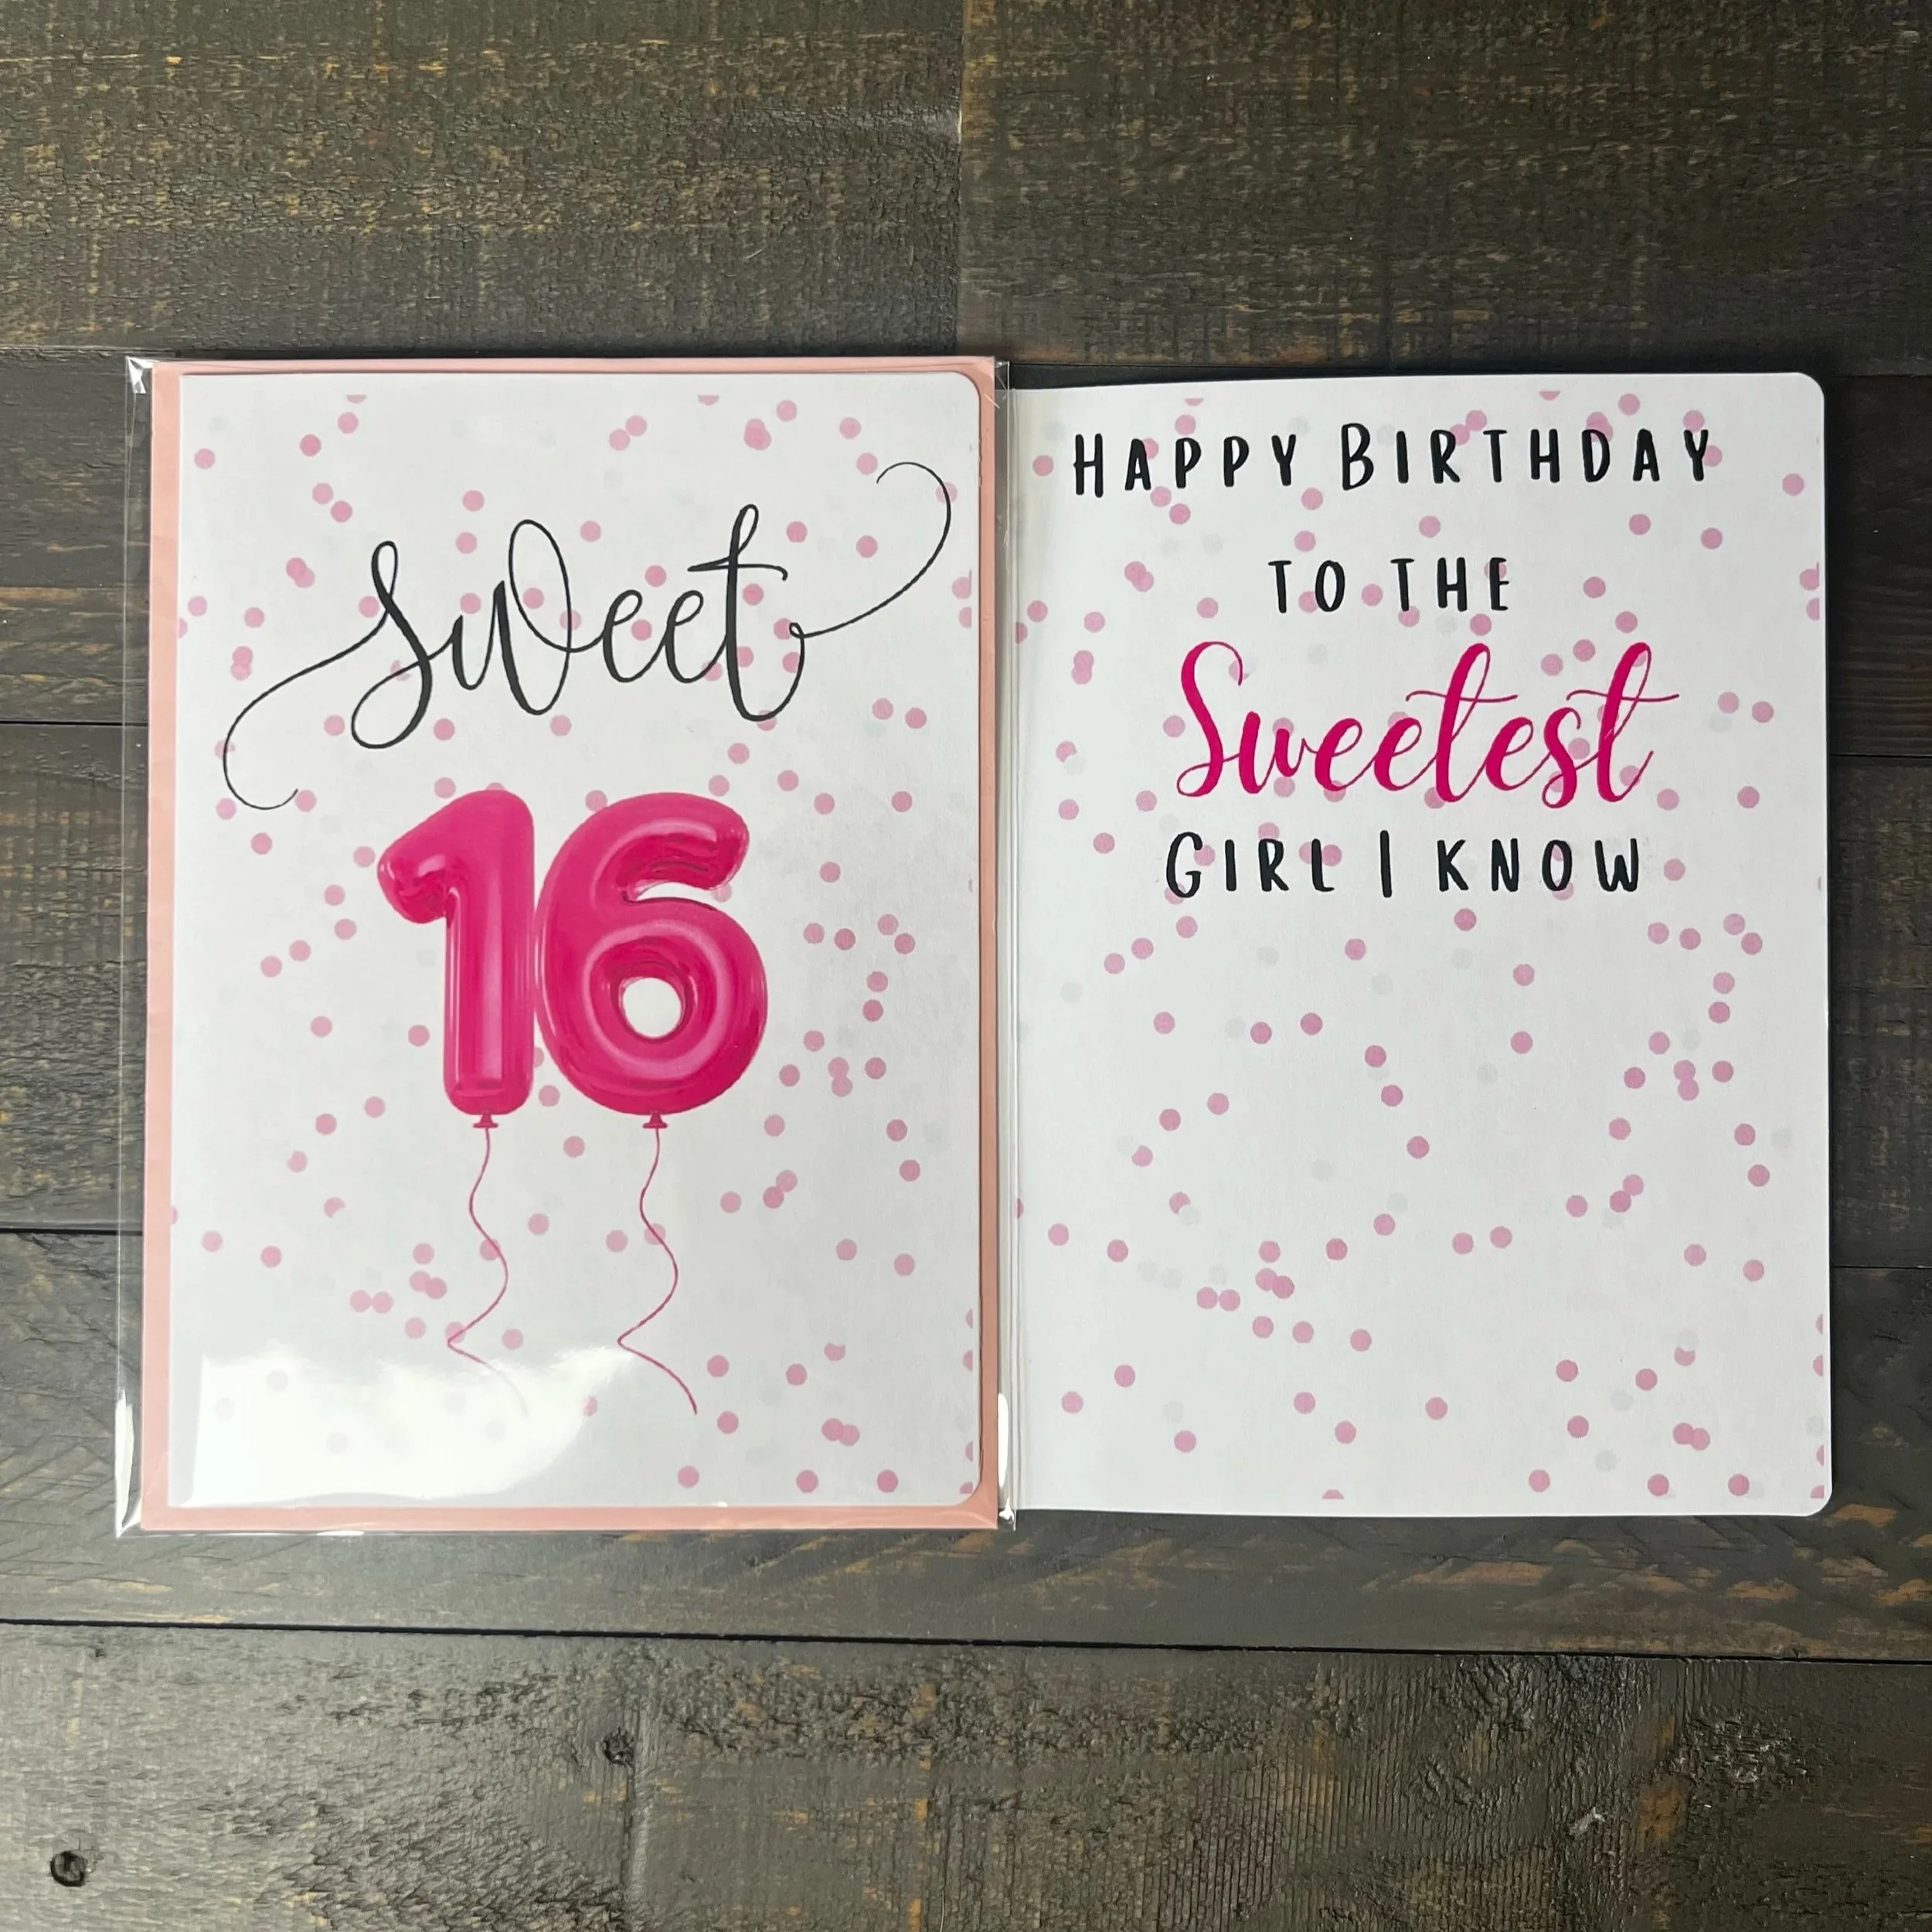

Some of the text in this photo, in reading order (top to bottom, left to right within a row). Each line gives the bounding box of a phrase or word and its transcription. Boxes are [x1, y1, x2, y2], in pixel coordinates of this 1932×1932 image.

[1073, 423, 1714, 498] HAPPY BIRTHDAY
[1267, 556, 1509, 614] TO THE
[1176, 642, 1679, 808] Sweetest
[1165, 830, 1639, 898] GIRL I KNOW
[379, 790, 767, 1117] 16
